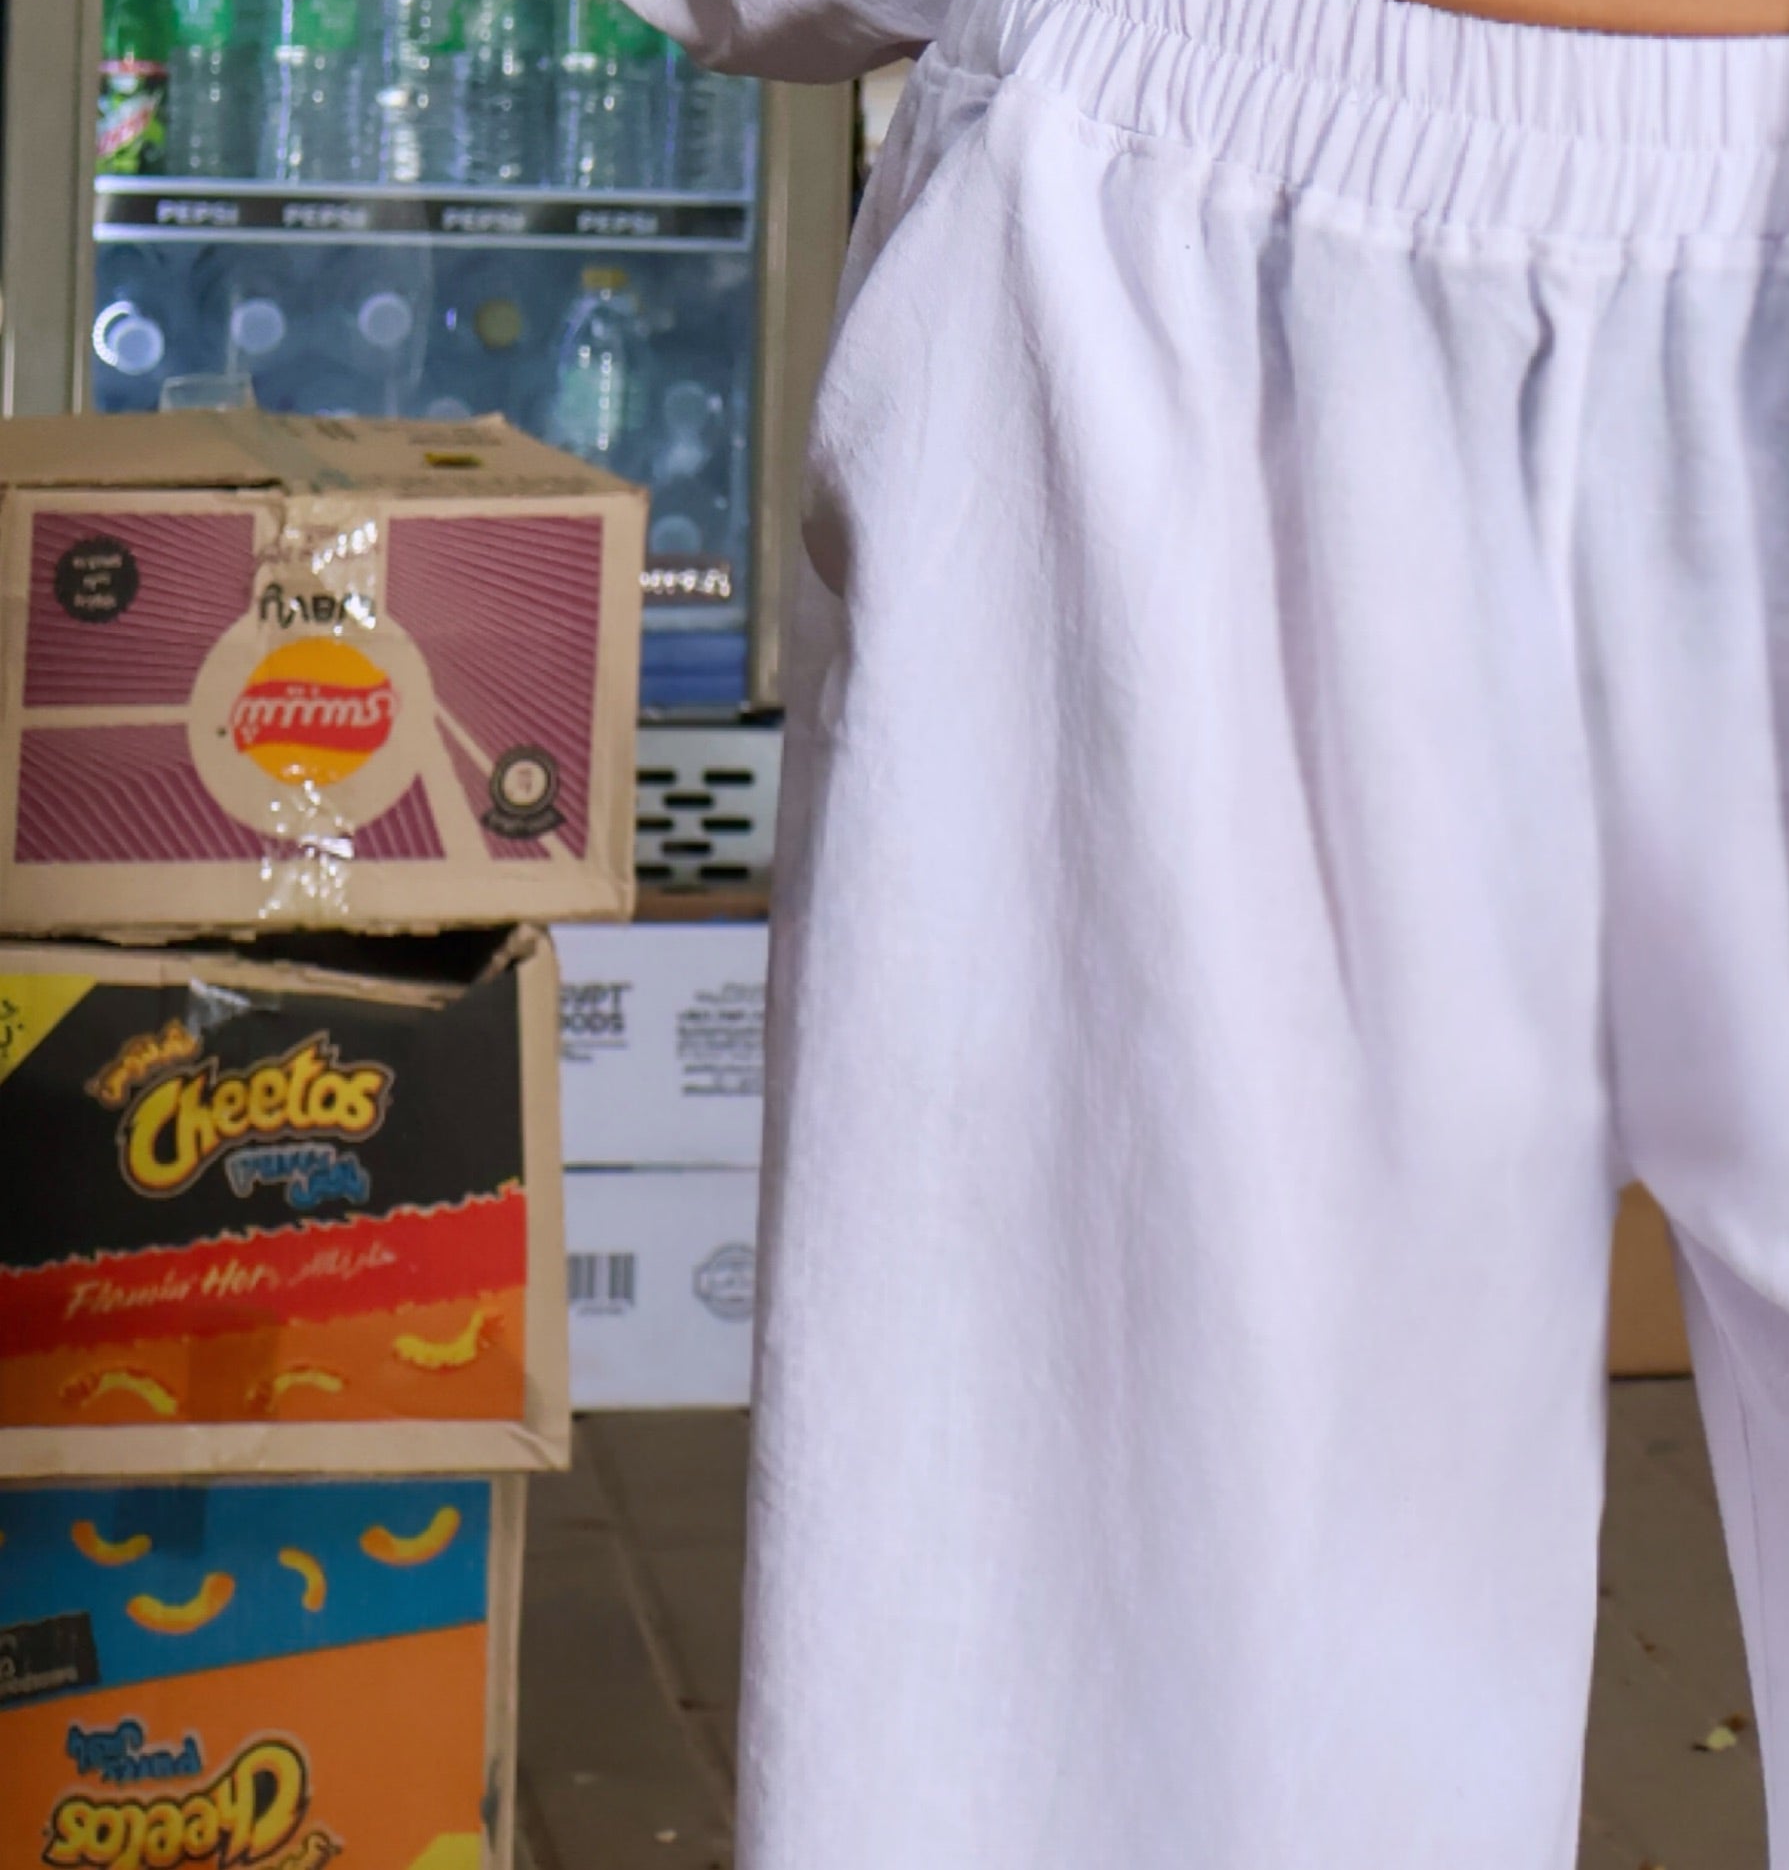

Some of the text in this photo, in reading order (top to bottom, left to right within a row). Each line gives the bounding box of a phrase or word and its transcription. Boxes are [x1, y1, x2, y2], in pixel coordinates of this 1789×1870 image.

[156, 199, 239, 226] PEPSI
[124, 1043, 388, 1191] Cheetos
[54, 1743, 307, 1869] Cheetos
